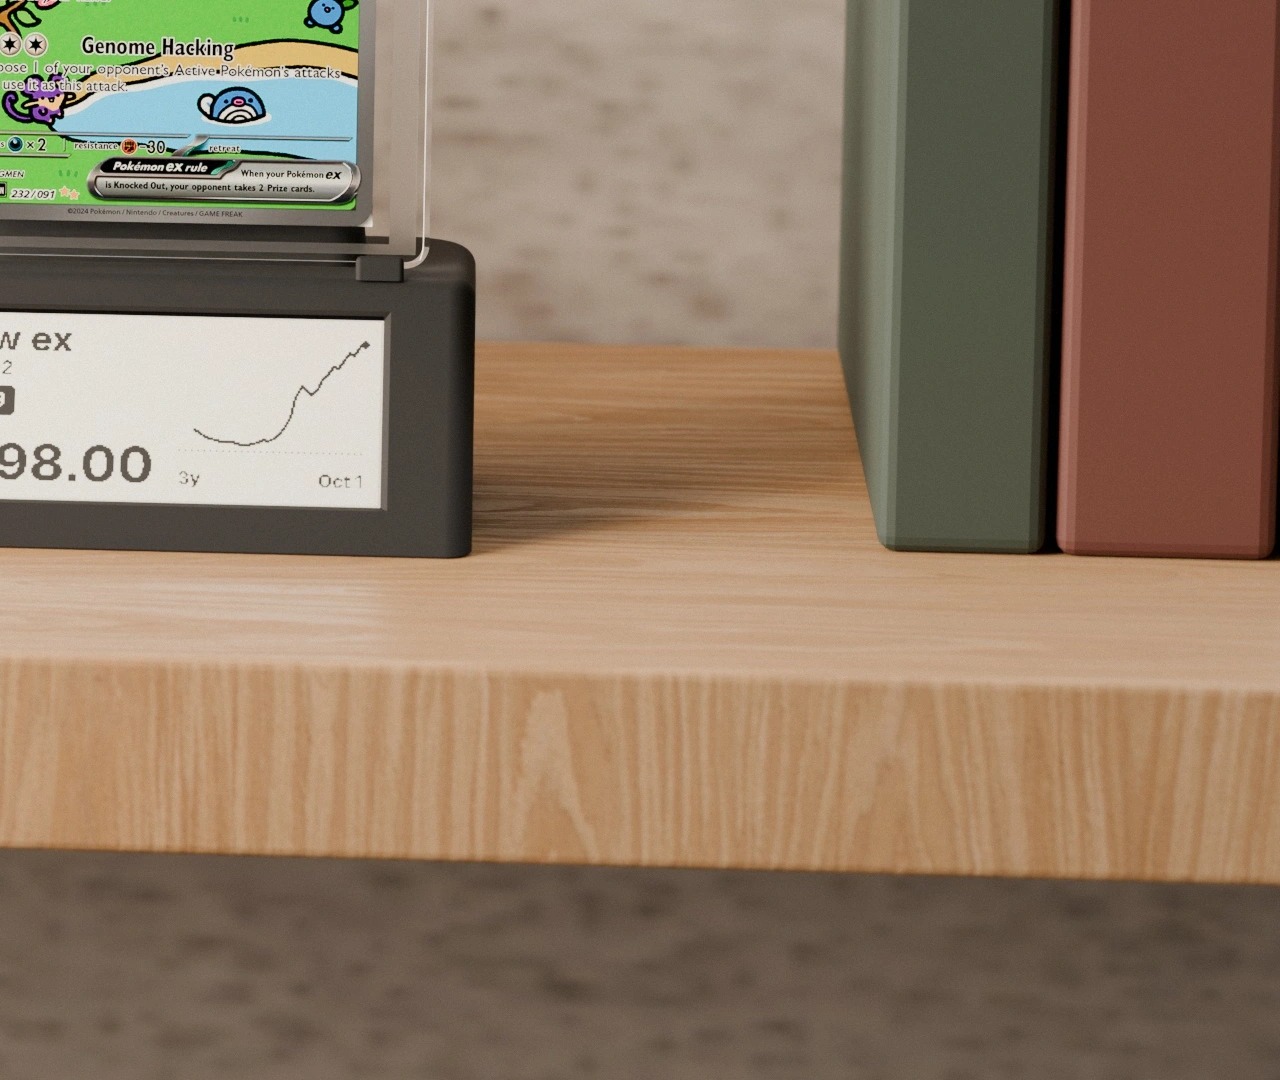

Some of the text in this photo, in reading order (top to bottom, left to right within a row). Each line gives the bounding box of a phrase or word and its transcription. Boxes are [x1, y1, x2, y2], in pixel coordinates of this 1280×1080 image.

[82, 36, 234, 61] Genome Hacking
[113, 160, 208, 173] Pokémon ex rule
[241, 169, 342, 180] When your Pokémon ex
[105, 181, 315, 193] is Knocked Out, your opponent takes 2 Prize cards.
[11, 189, 56, 200] 232/091
[31, 332, 72, 352] ex
[178, 471, 200, 487] 3y
[318, 474, 362, 489] Oct 1
